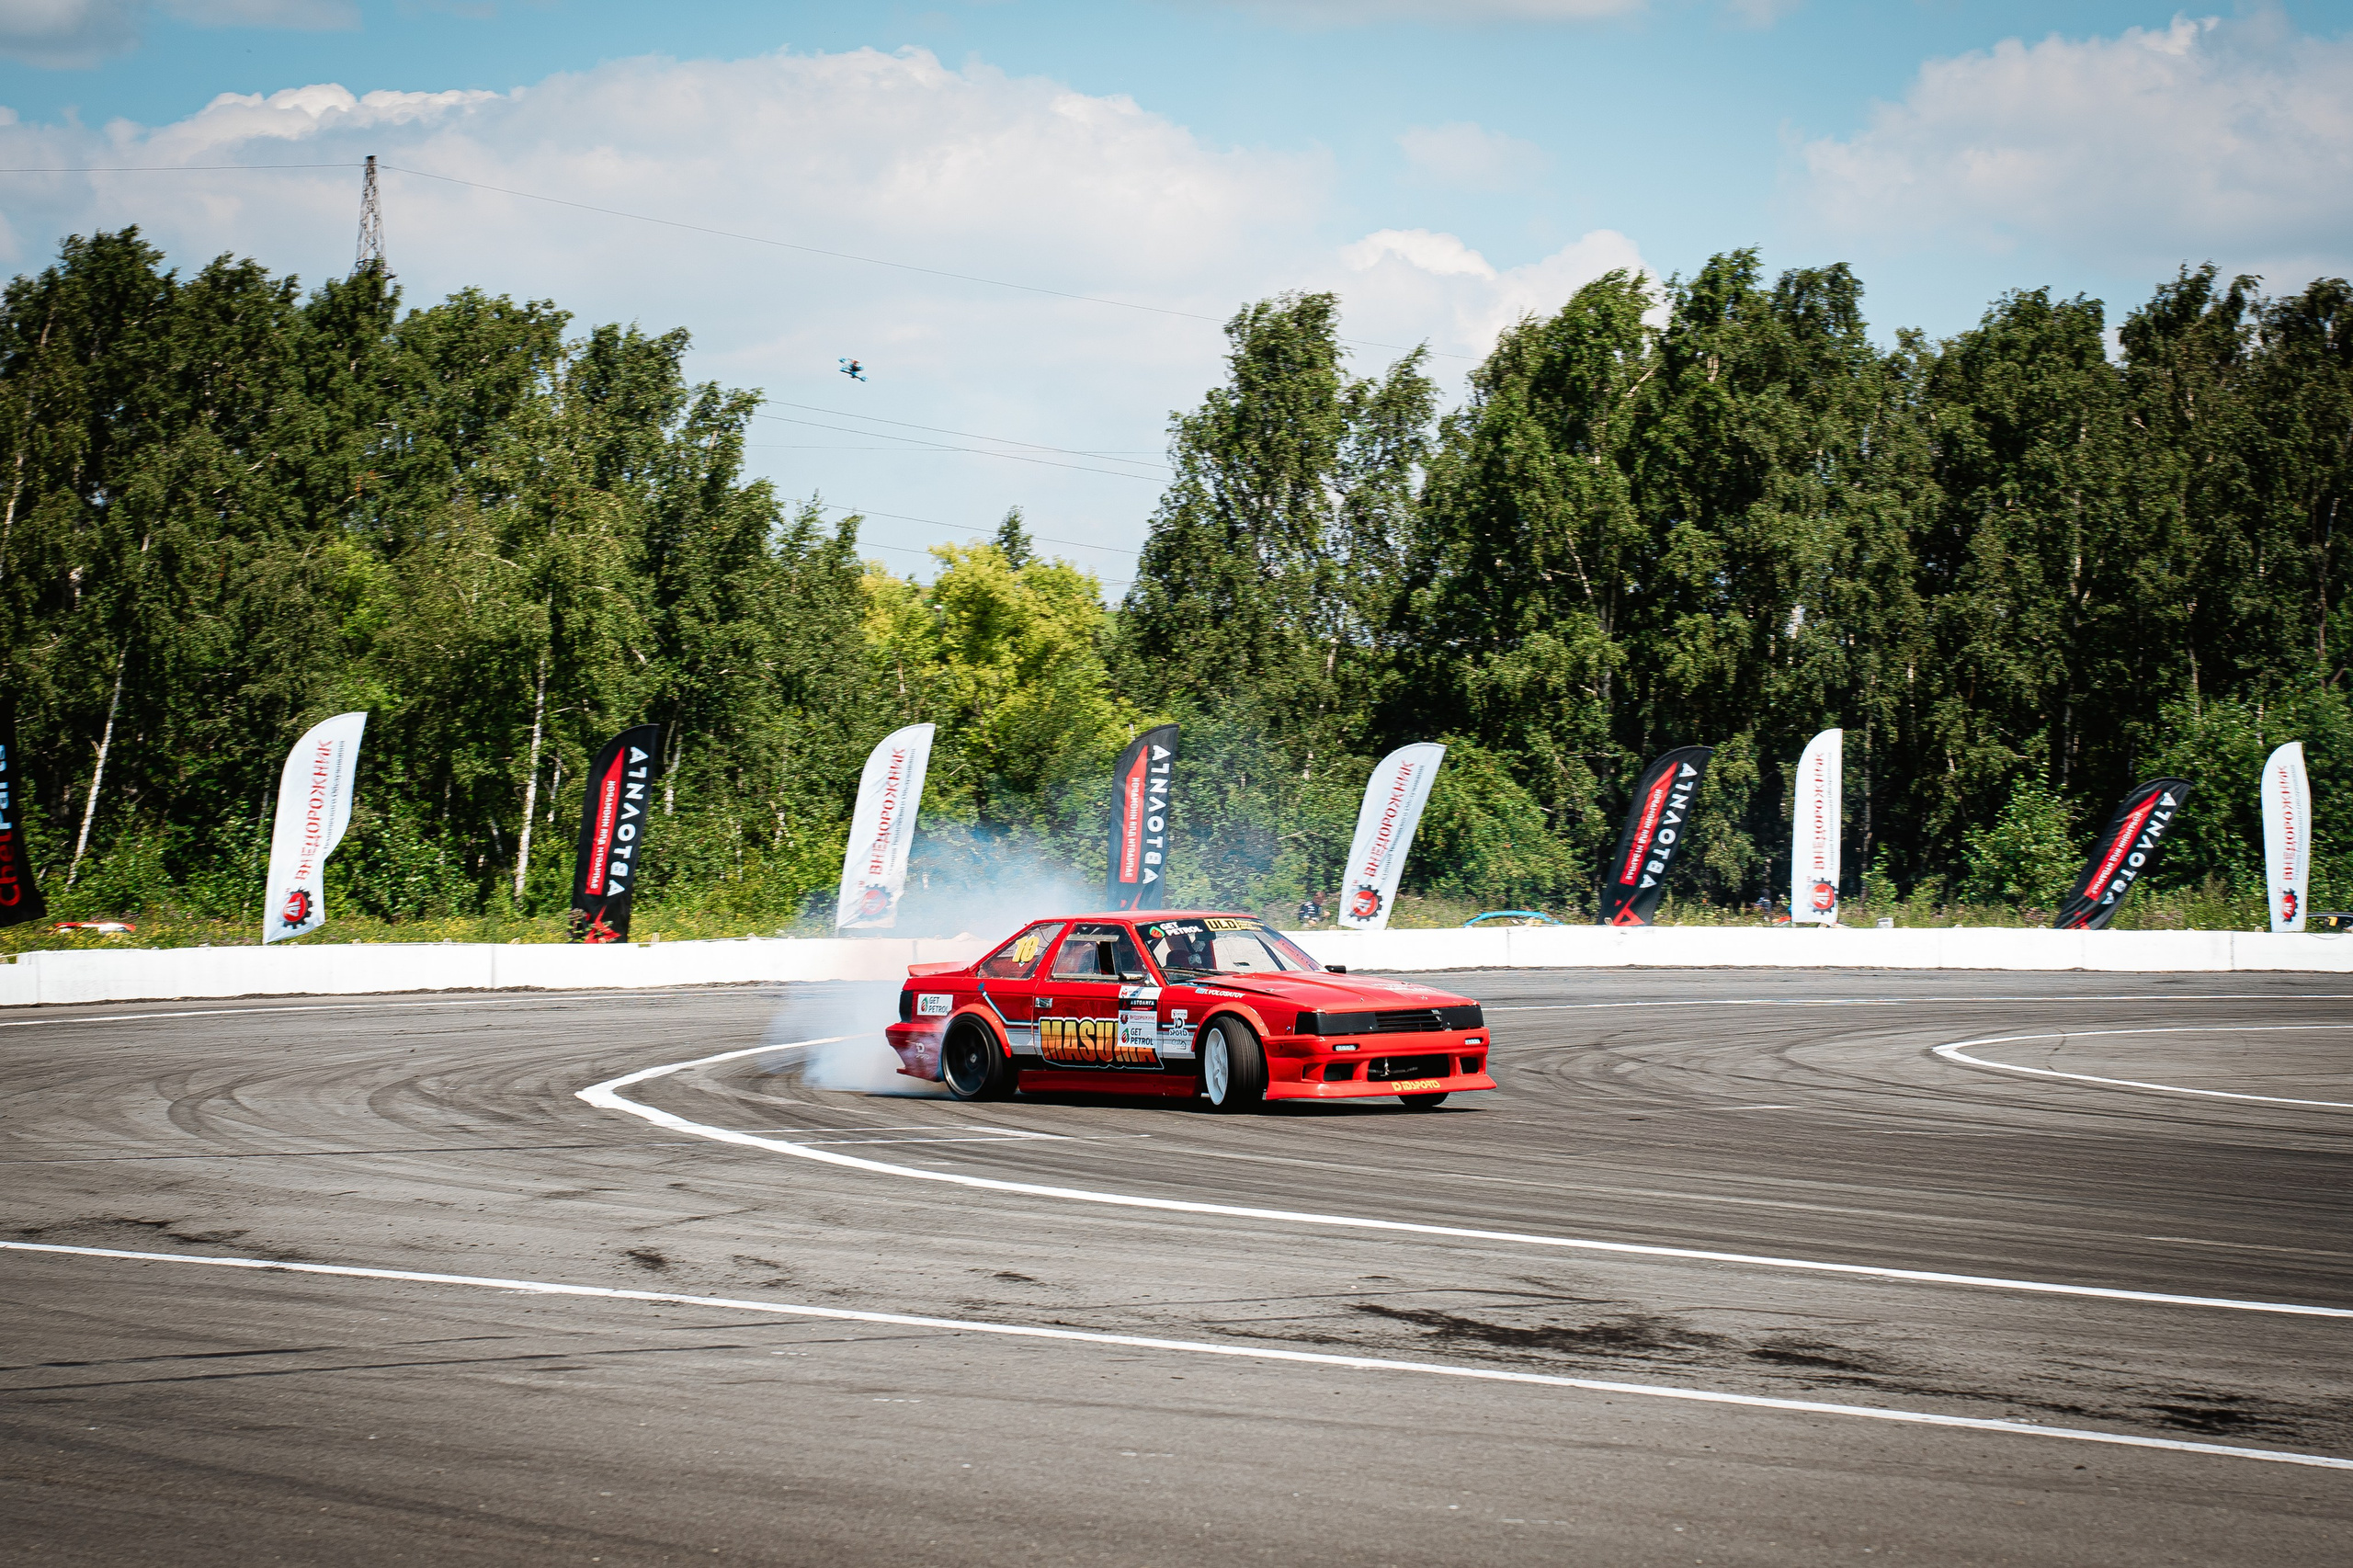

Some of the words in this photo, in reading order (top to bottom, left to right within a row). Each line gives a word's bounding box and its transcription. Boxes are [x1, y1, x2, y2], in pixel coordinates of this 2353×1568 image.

[295, 739, 333, 881] ВНЕДОРОЖНИК
[870, 747, 906, 875] ВНЕДОРОЖНИК
[1364, 759, 1415, 877] ВНЕДОРОЖНИК
[1813, 752, 1825, 870] ВНЕДОРОЖНИК
[2277, 765, 2296, 881] ВНЕДОРОЖНИК
[1160, 921, 1179, 930] GET
[1165, 926, 1203, 937] PETROL
[1815, 890, 1830, 906] 4L
[1131, 1037, 1154, 1045] PETROL
